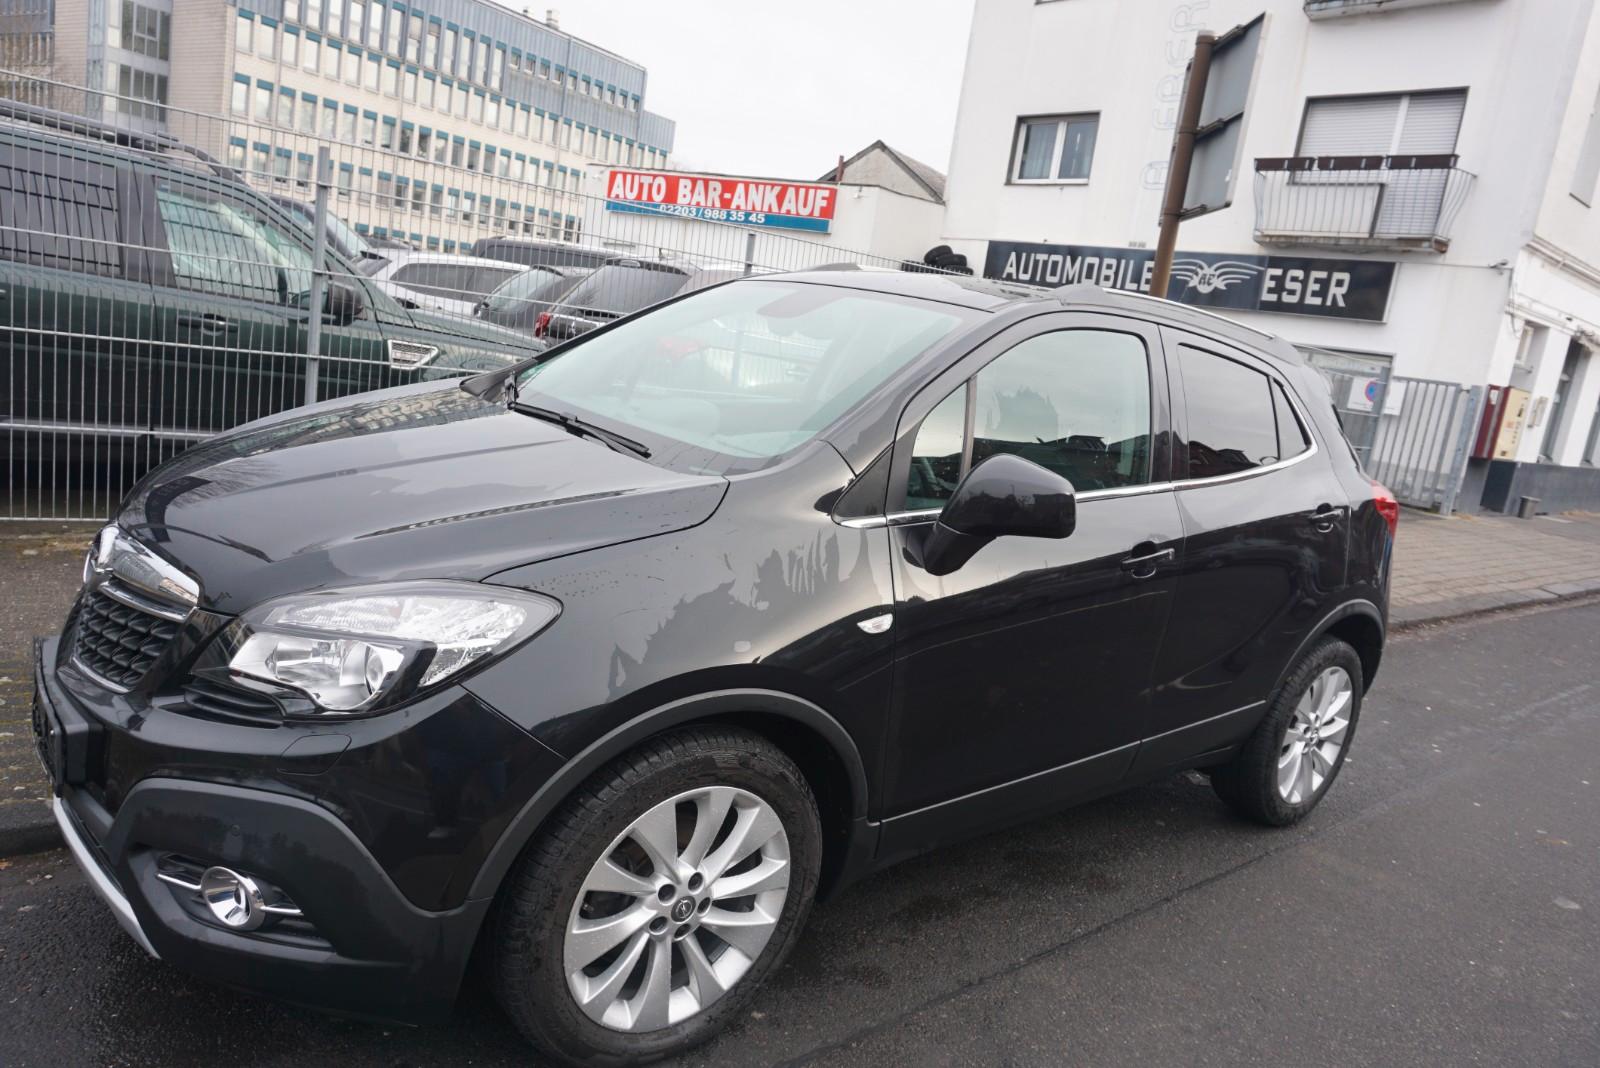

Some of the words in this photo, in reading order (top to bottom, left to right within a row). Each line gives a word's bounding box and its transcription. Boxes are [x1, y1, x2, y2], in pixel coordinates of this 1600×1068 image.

[610, 173, 667, 203] AUTO
[676, 178, 831, 217] BAR-ANKAUF
[729, 211, 745, 221] 35
[748, 213, 766, 223] 45
[1002, 251, 1156, 292] AUTOMOBILE
[1261, 267, 1351, 307] ESER
